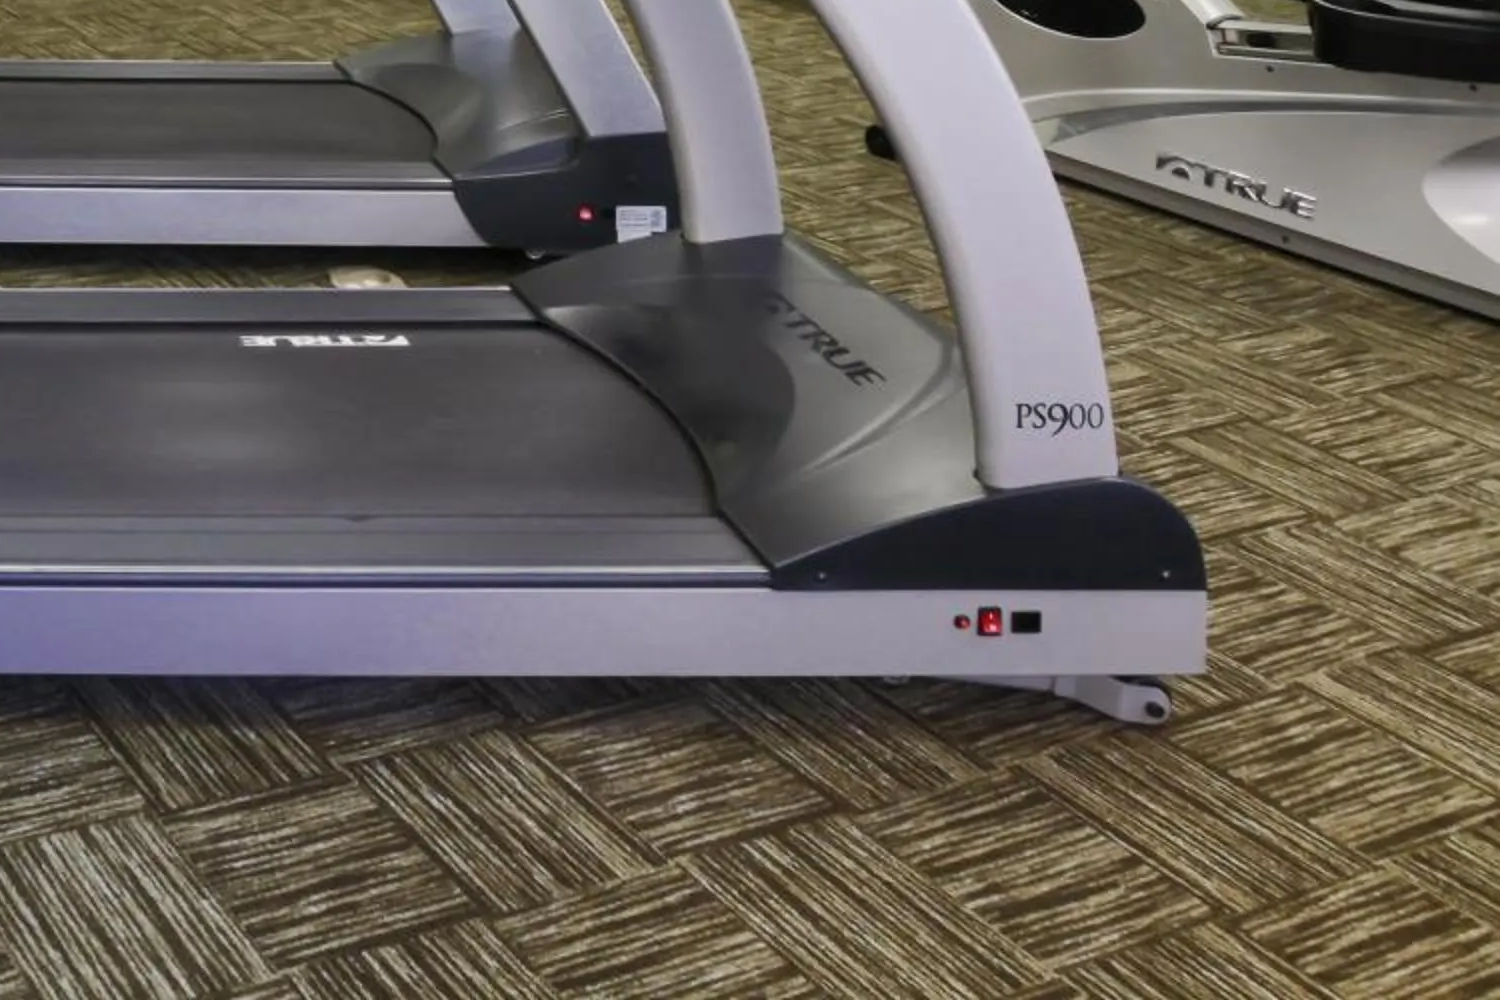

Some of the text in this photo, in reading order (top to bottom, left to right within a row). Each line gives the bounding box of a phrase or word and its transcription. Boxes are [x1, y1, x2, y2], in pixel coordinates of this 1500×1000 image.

[1201, 163, 1317, 219] TRUE
[783, 312, 888, 387] TRUE
[1015, 402, 1105, 438] PS900
